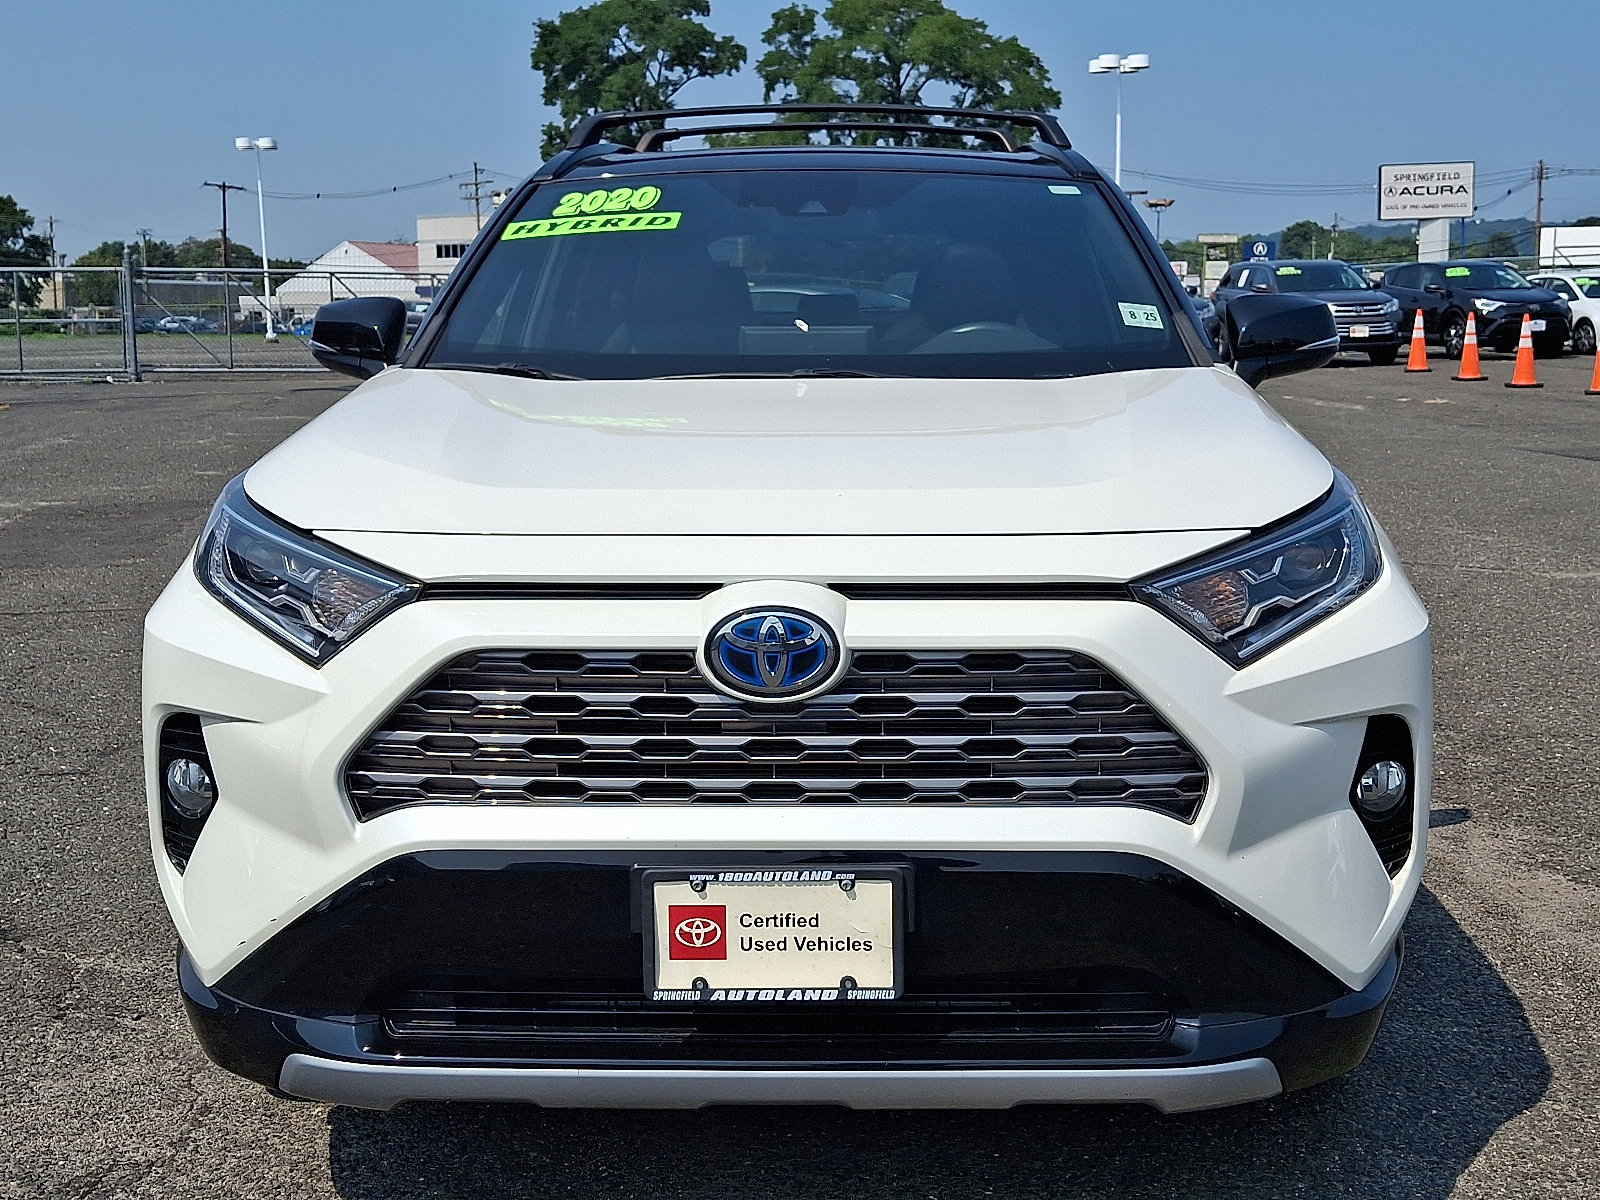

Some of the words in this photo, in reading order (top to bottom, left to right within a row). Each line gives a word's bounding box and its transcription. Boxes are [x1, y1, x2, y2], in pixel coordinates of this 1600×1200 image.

[1393, 172, 1461, 181] SPRINGFIELD
[1399, 185, 1468, 196] ACURA
[552, 186, 662, 217] 2020
[510, 216, 672, 236] HYBRID
[1129, 311, 1137, 319] 8
[1143, 312, 1157, 321] 25
[689, 870, 856, 882] www.1800AUTOLAND.com
[739, 912, 820, 928] Certified
[740, 936, 788, 952] Used
[794, 936, 874, 952] Vehicles
[653, 990, 701, 1001] SPRINGFIELD
[710, 989, 839, 1001] AUTOLAND
[847, 989, 896, 1000] SPRINGFIELD
